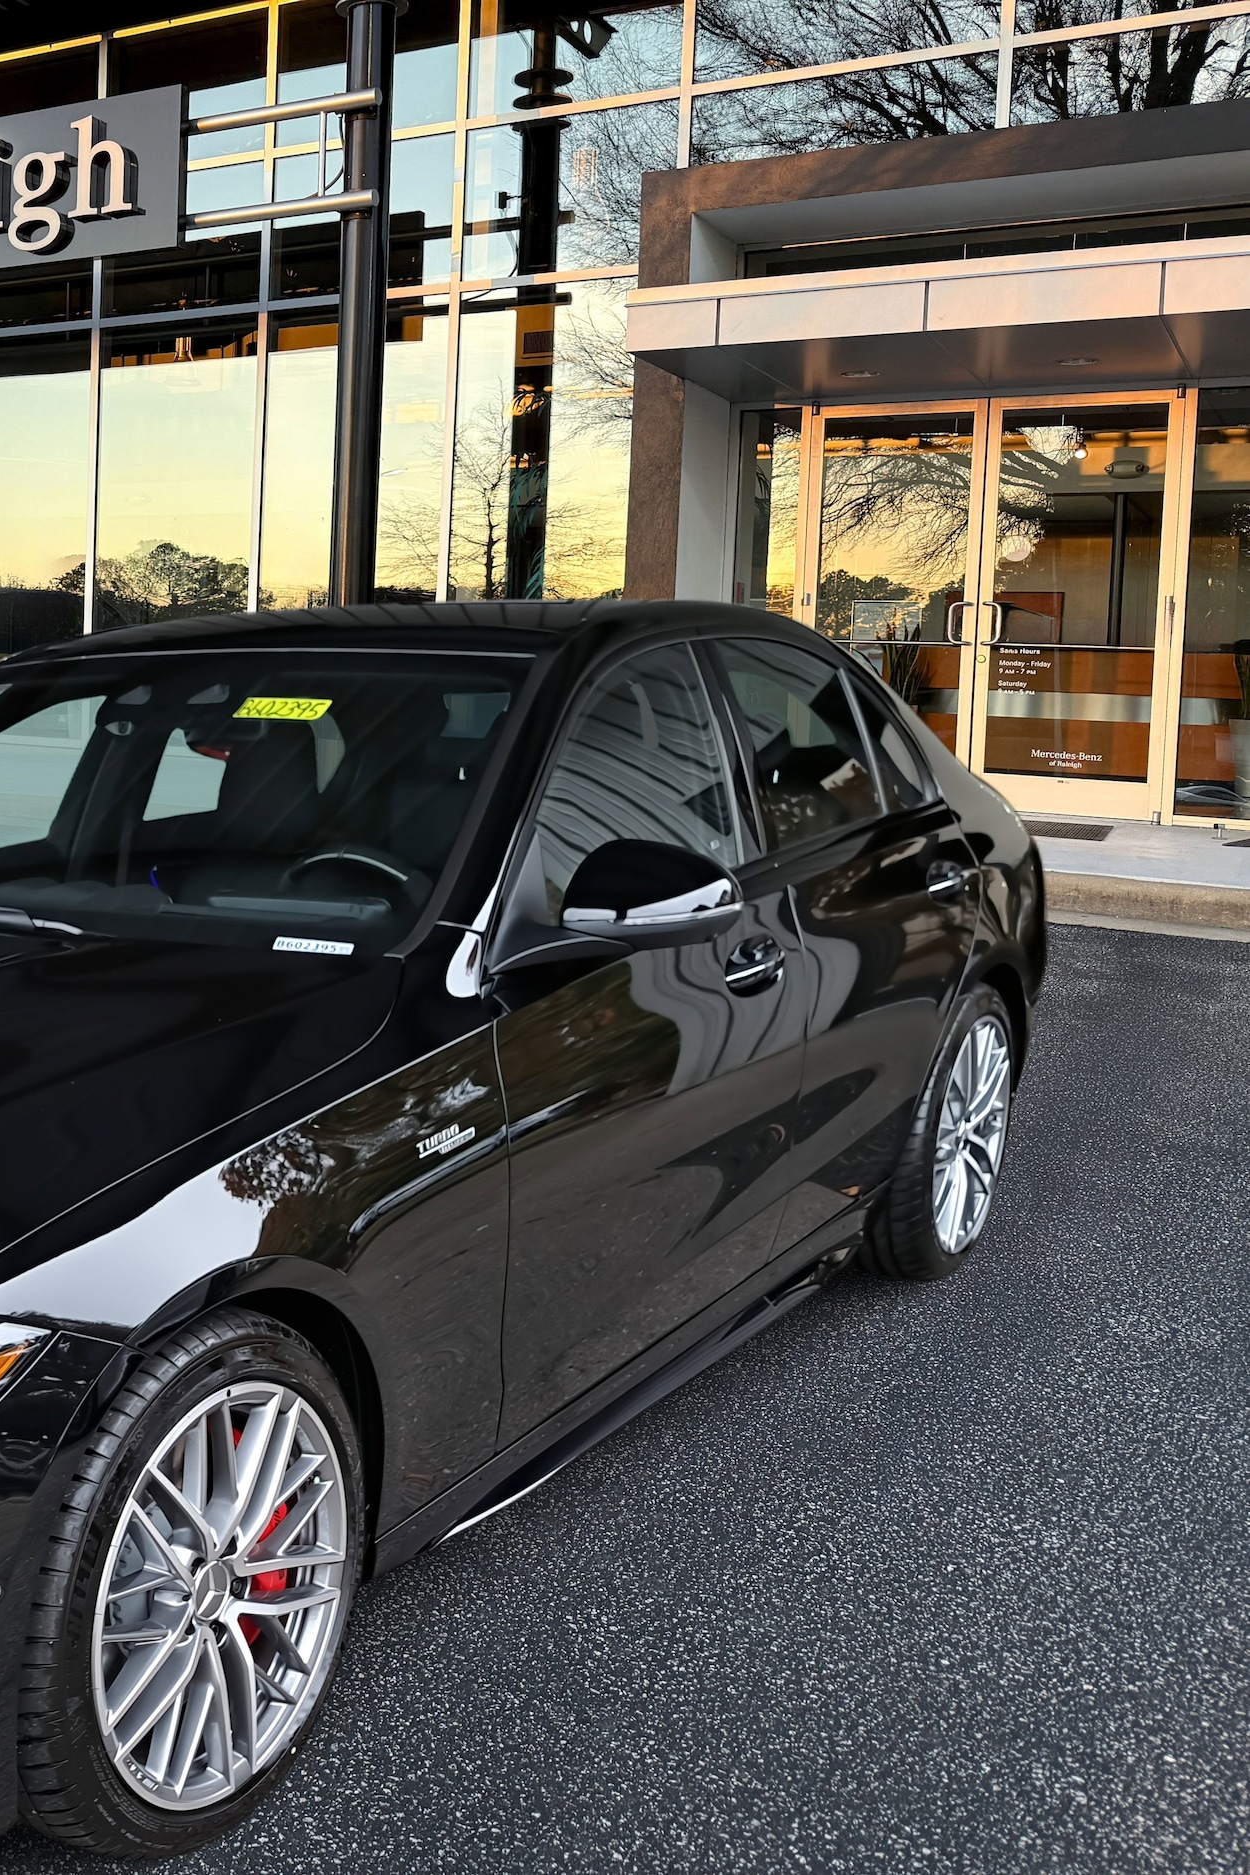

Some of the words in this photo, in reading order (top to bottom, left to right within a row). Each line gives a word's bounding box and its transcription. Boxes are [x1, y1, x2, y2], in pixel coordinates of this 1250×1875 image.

[998, 680, 1027, 688] Saturday
[1031, 749, 1103, 761] Mercedes-Benz
[416, 1123, 460, 1154] TURBO
